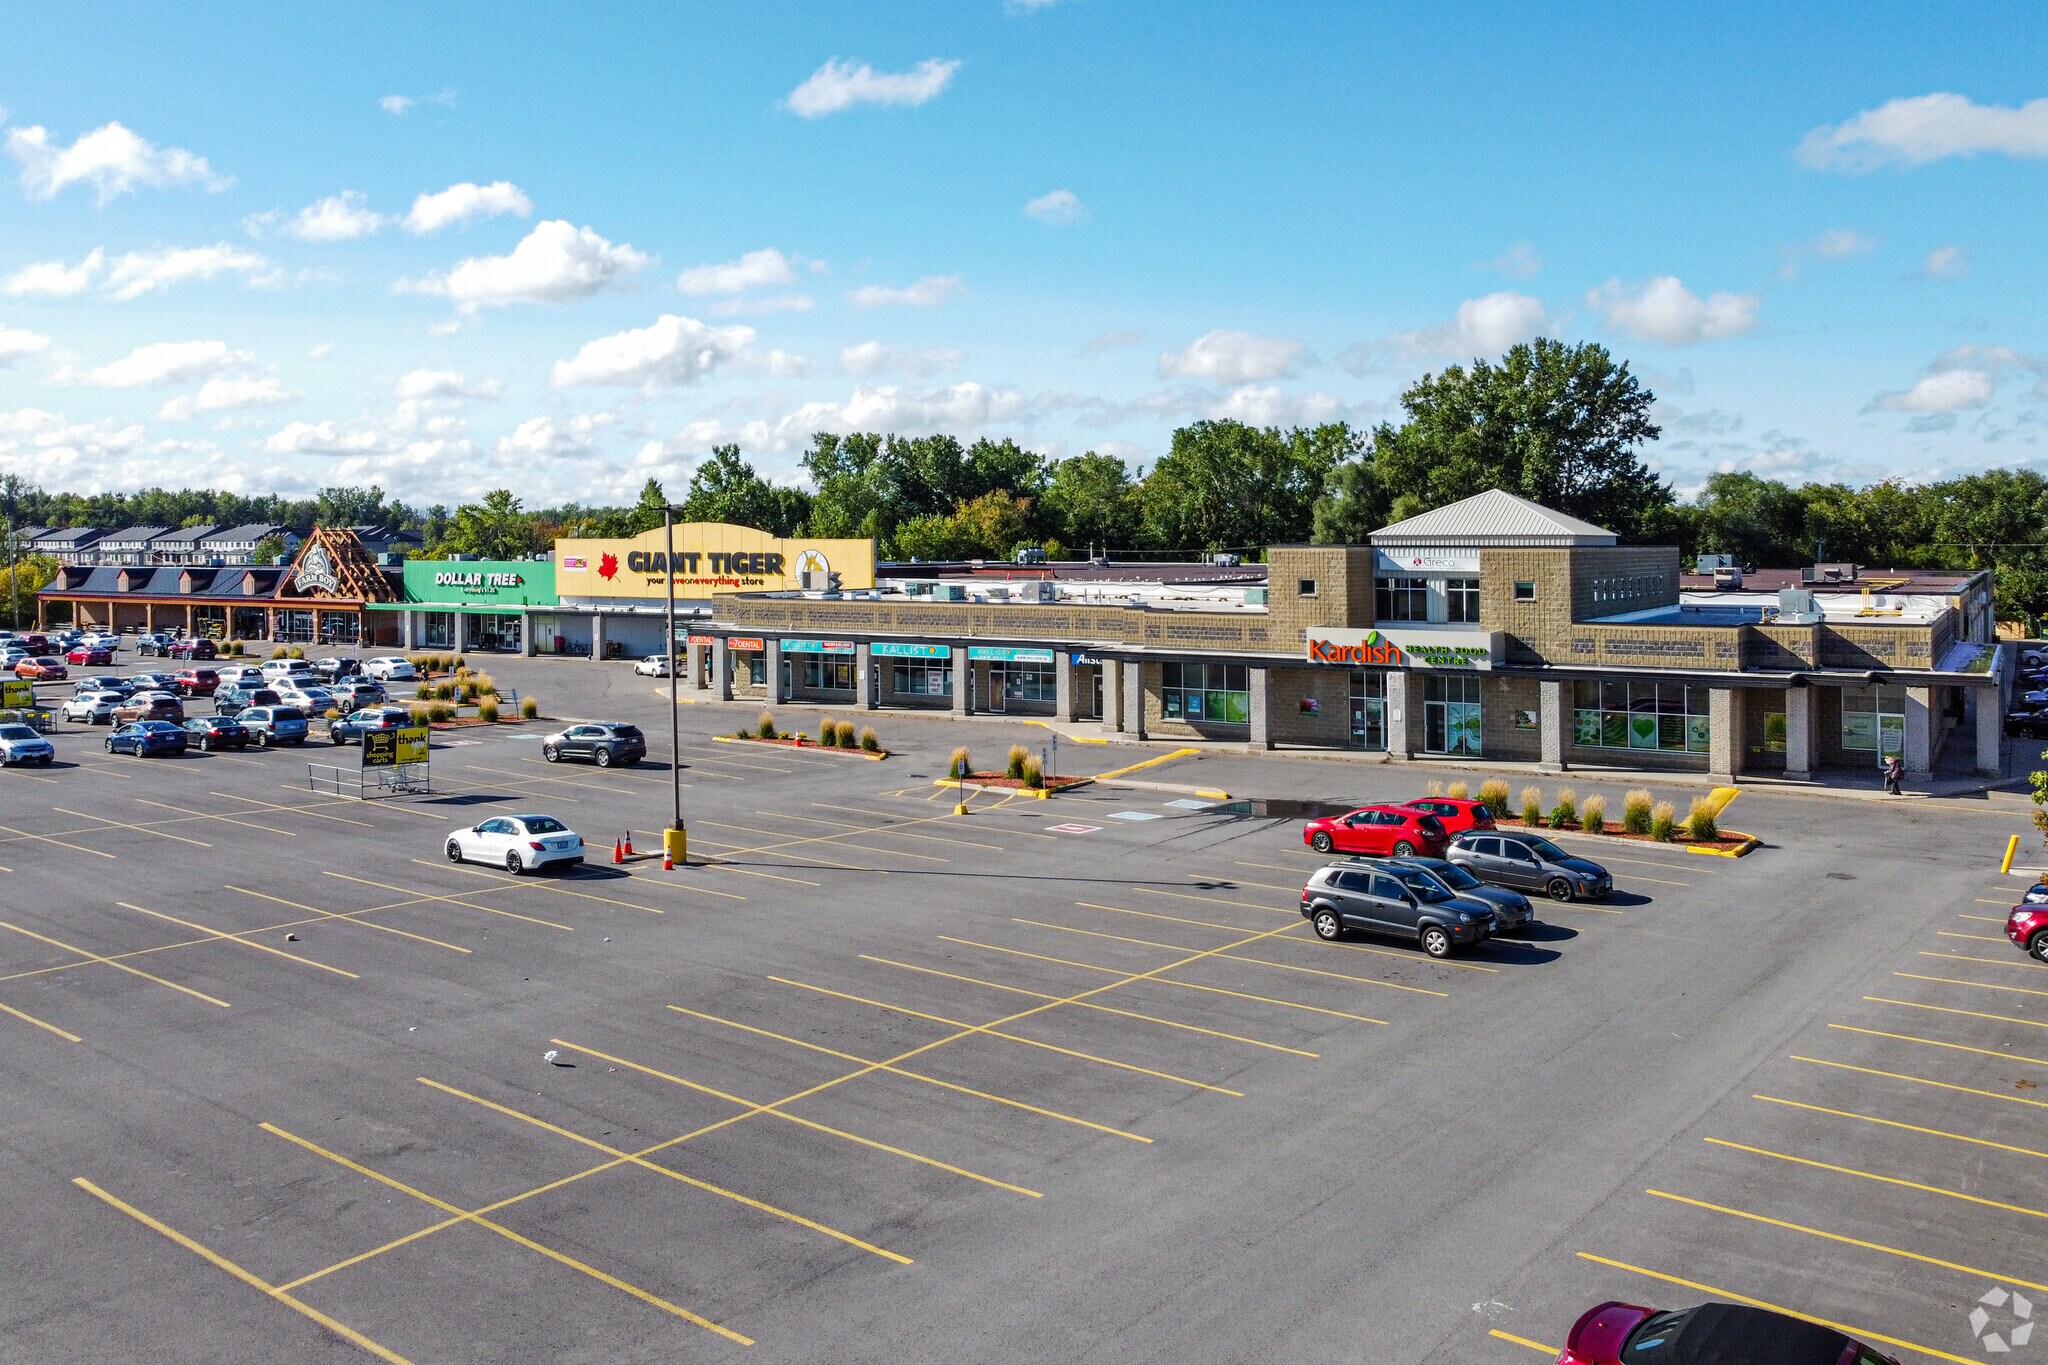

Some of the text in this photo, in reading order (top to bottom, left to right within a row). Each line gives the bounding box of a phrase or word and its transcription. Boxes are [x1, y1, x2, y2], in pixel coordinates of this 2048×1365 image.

[628, 551, 785, 575] GIANT TIGER
[1423, 557, 1456, 568] Greco
[297, 574, 335, 587] FARM BOY
[435, 572, 517, 587] DOLLAR TREE
[646, 577, 665, 587] your
[741, 576, 765, 586] store
[1309, 638, 1402, 665] Kardish
[1405, 645, 1487, 656] HEALTH FOOD
[1076, 653, 1104, 665] Allst
[1424, 656, 1467, 666] CENTRE
[5, 685, 29, 693] thank
[398, 732, 426, 744] thank
